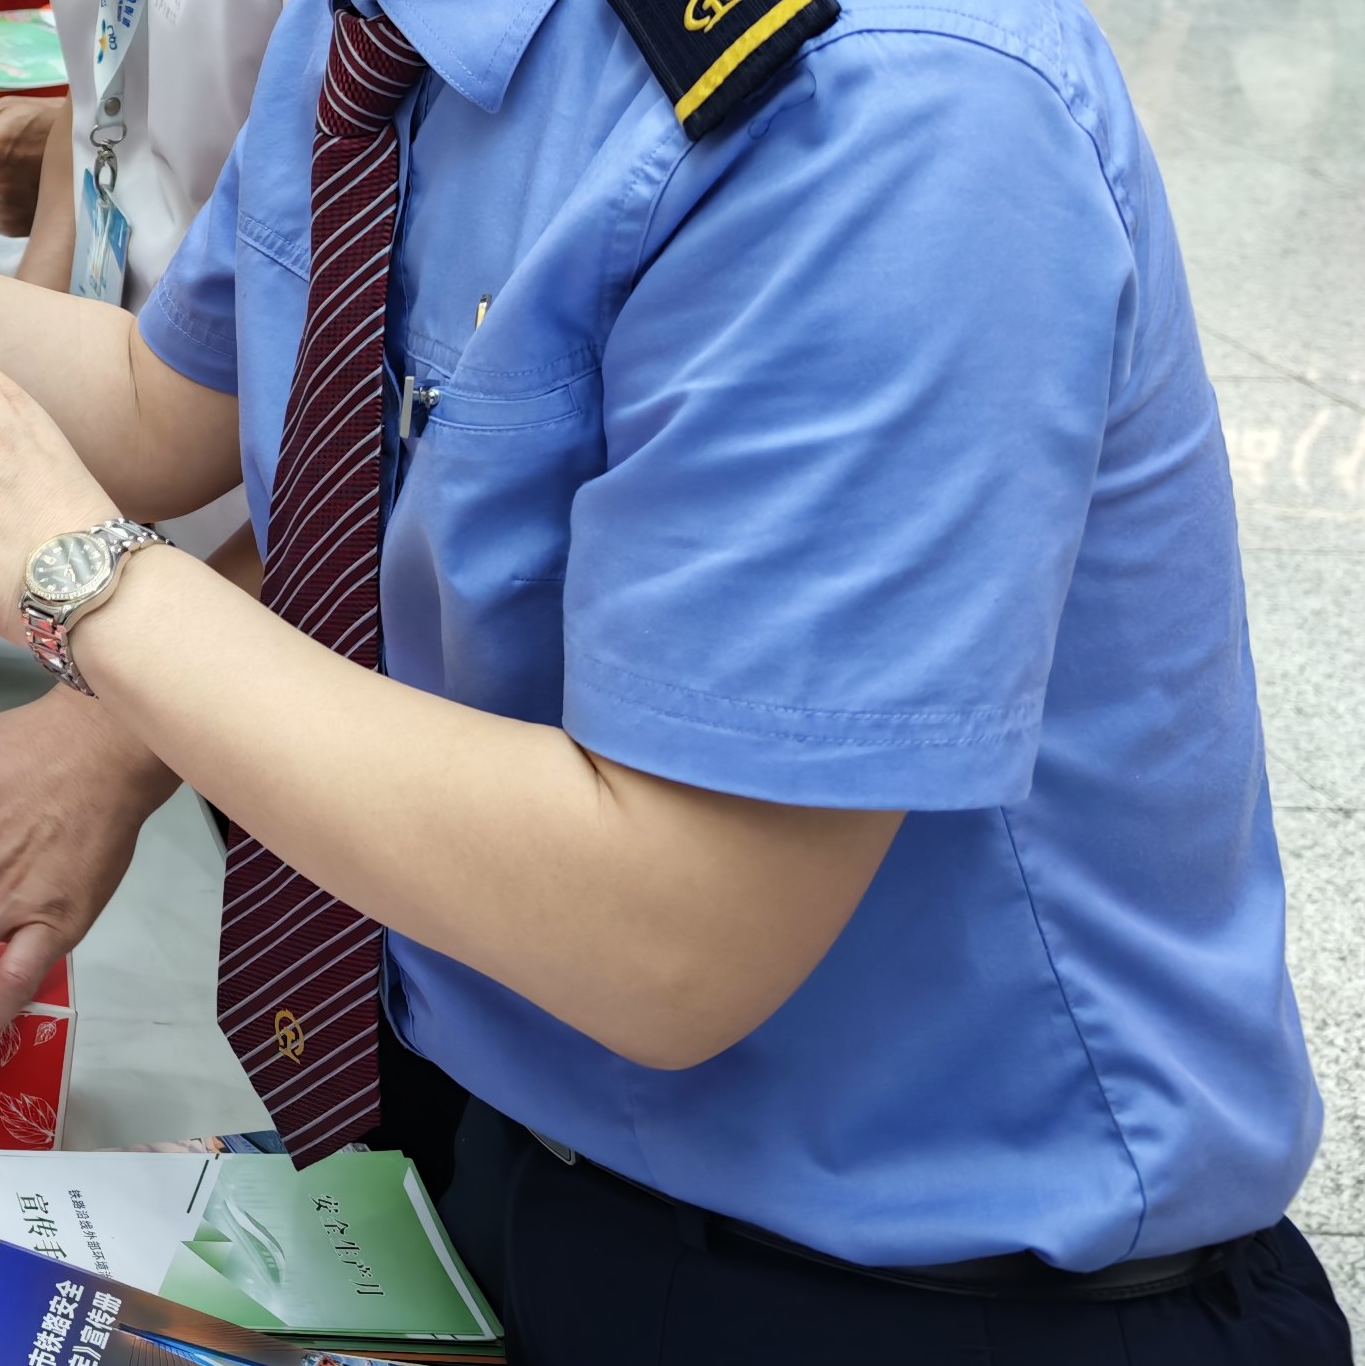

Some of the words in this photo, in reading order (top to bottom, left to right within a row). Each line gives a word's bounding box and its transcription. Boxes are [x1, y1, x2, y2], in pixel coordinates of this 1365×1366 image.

[309, 1195, 384, 1295] 安全生产月
